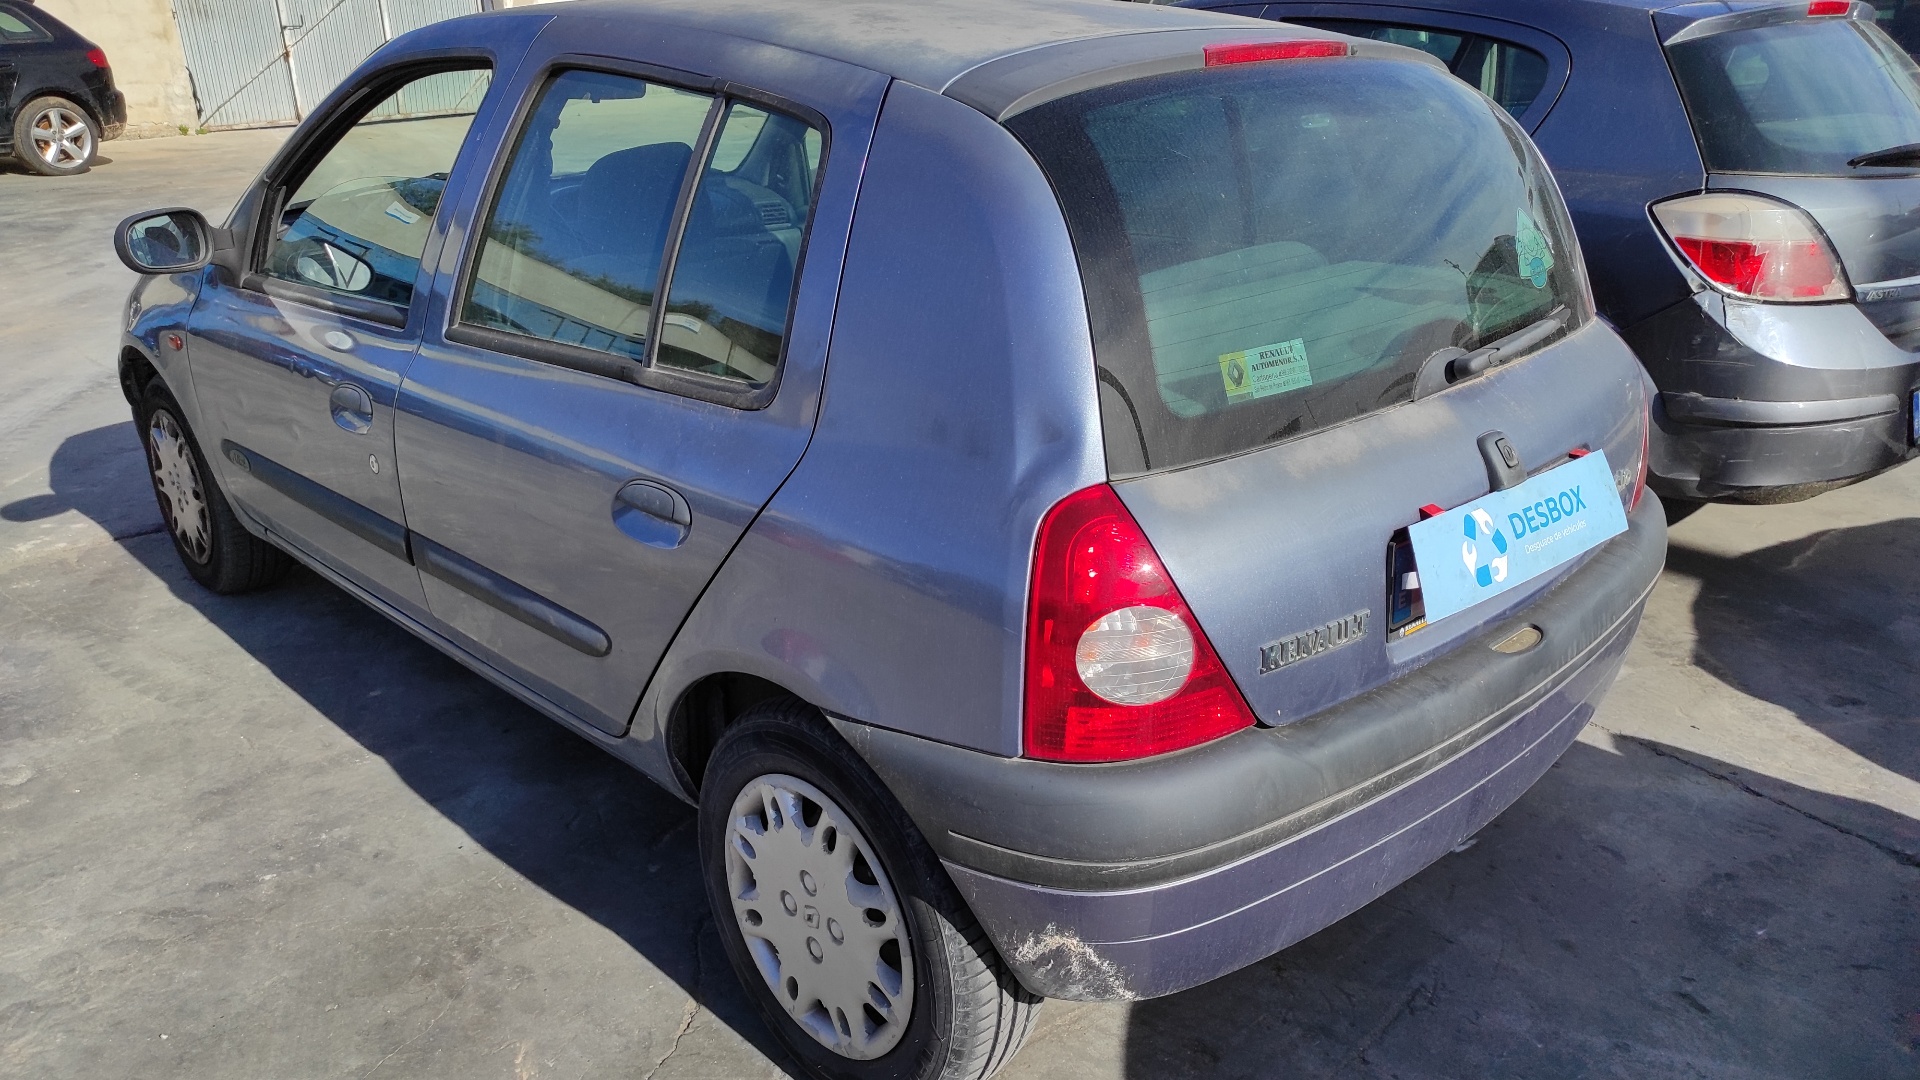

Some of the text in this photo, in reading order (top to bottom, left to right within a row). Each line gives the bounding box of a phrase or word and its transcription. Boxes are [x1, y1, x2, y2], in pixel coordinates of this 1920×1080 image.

[1866, 287, 1901, 301] ASTRA
[1259, 345, 1293, 360] RENAULT
[1508, 485, 1587, 540] DESBOX
[1524, 535, 1554, 554] Desguace
[1553, 530, 1562, 541] de
[1259, 608, 1371, 675] RENAULT
